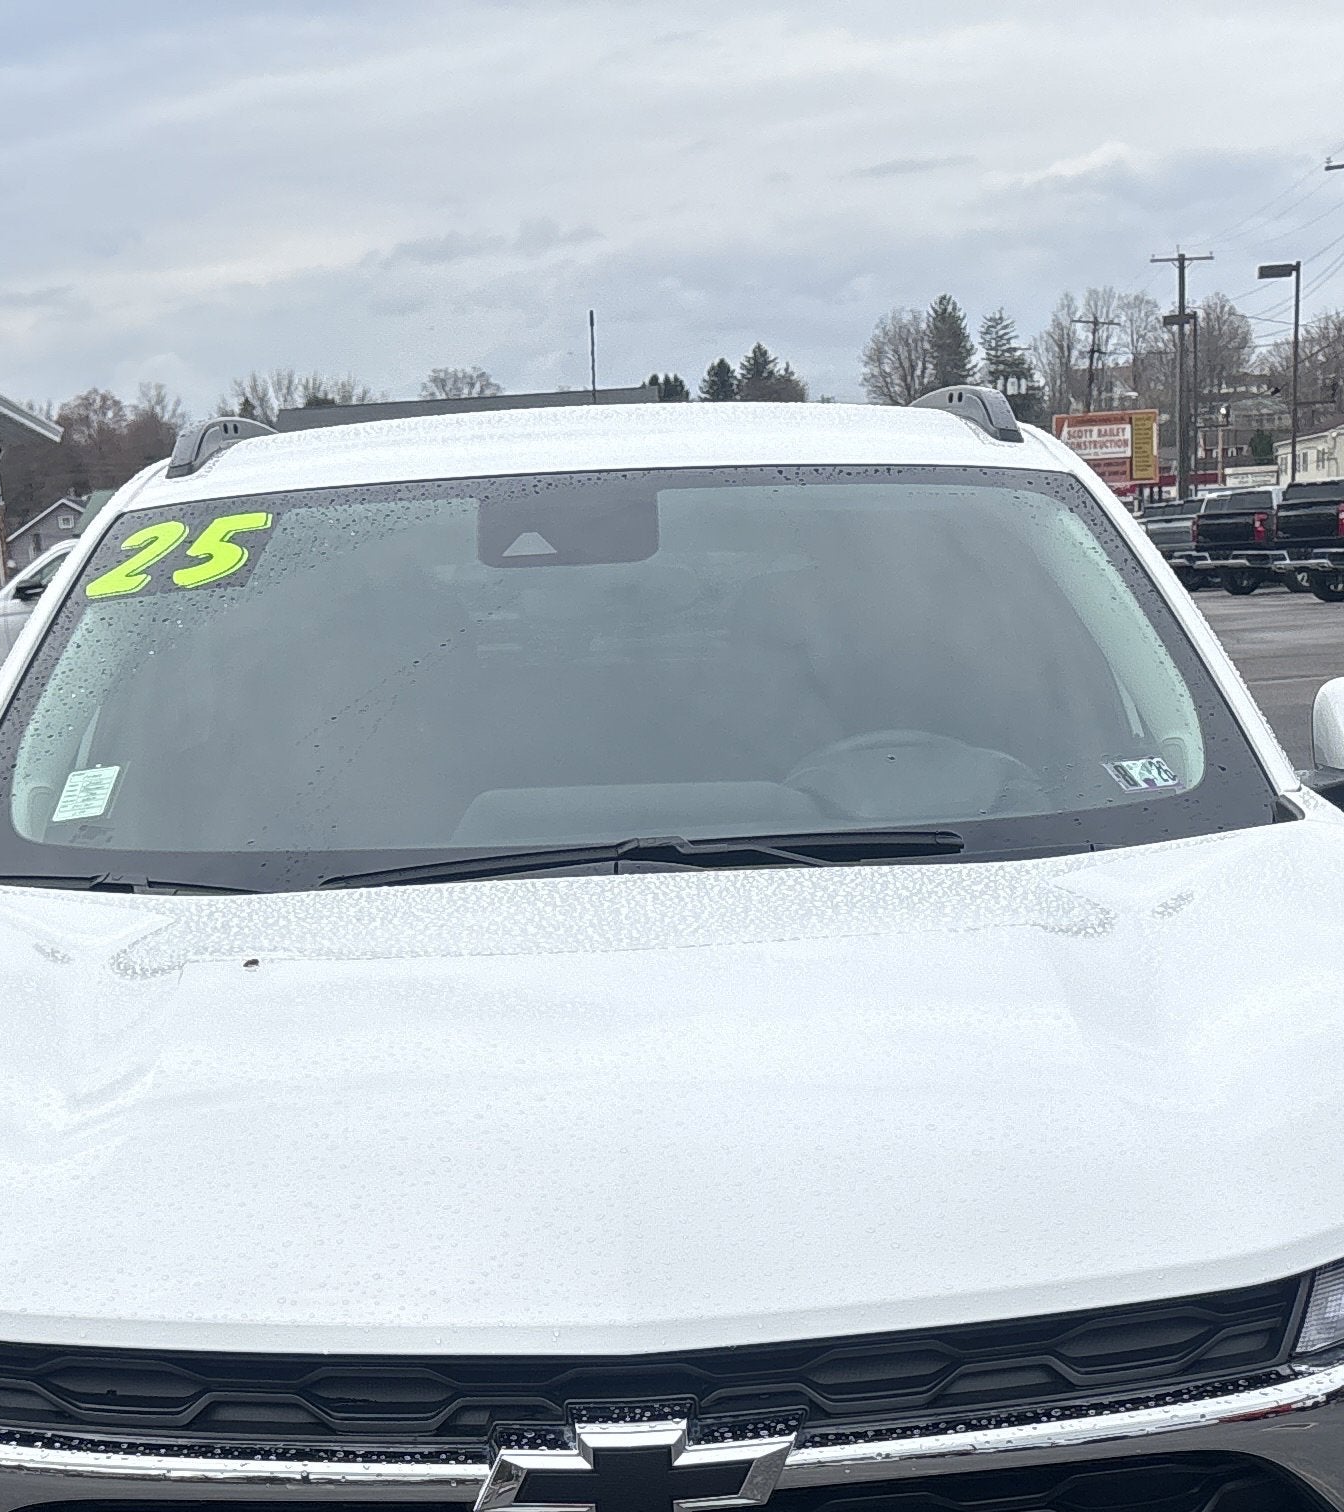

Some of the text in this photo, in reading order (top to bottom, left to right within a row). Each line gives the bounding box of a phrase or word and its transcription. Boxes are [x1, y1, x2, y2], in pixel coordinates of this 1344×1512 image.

[1067, 426, 1126, 440] SCOTT BAILEY
[85, 512, 273, 599] 25
